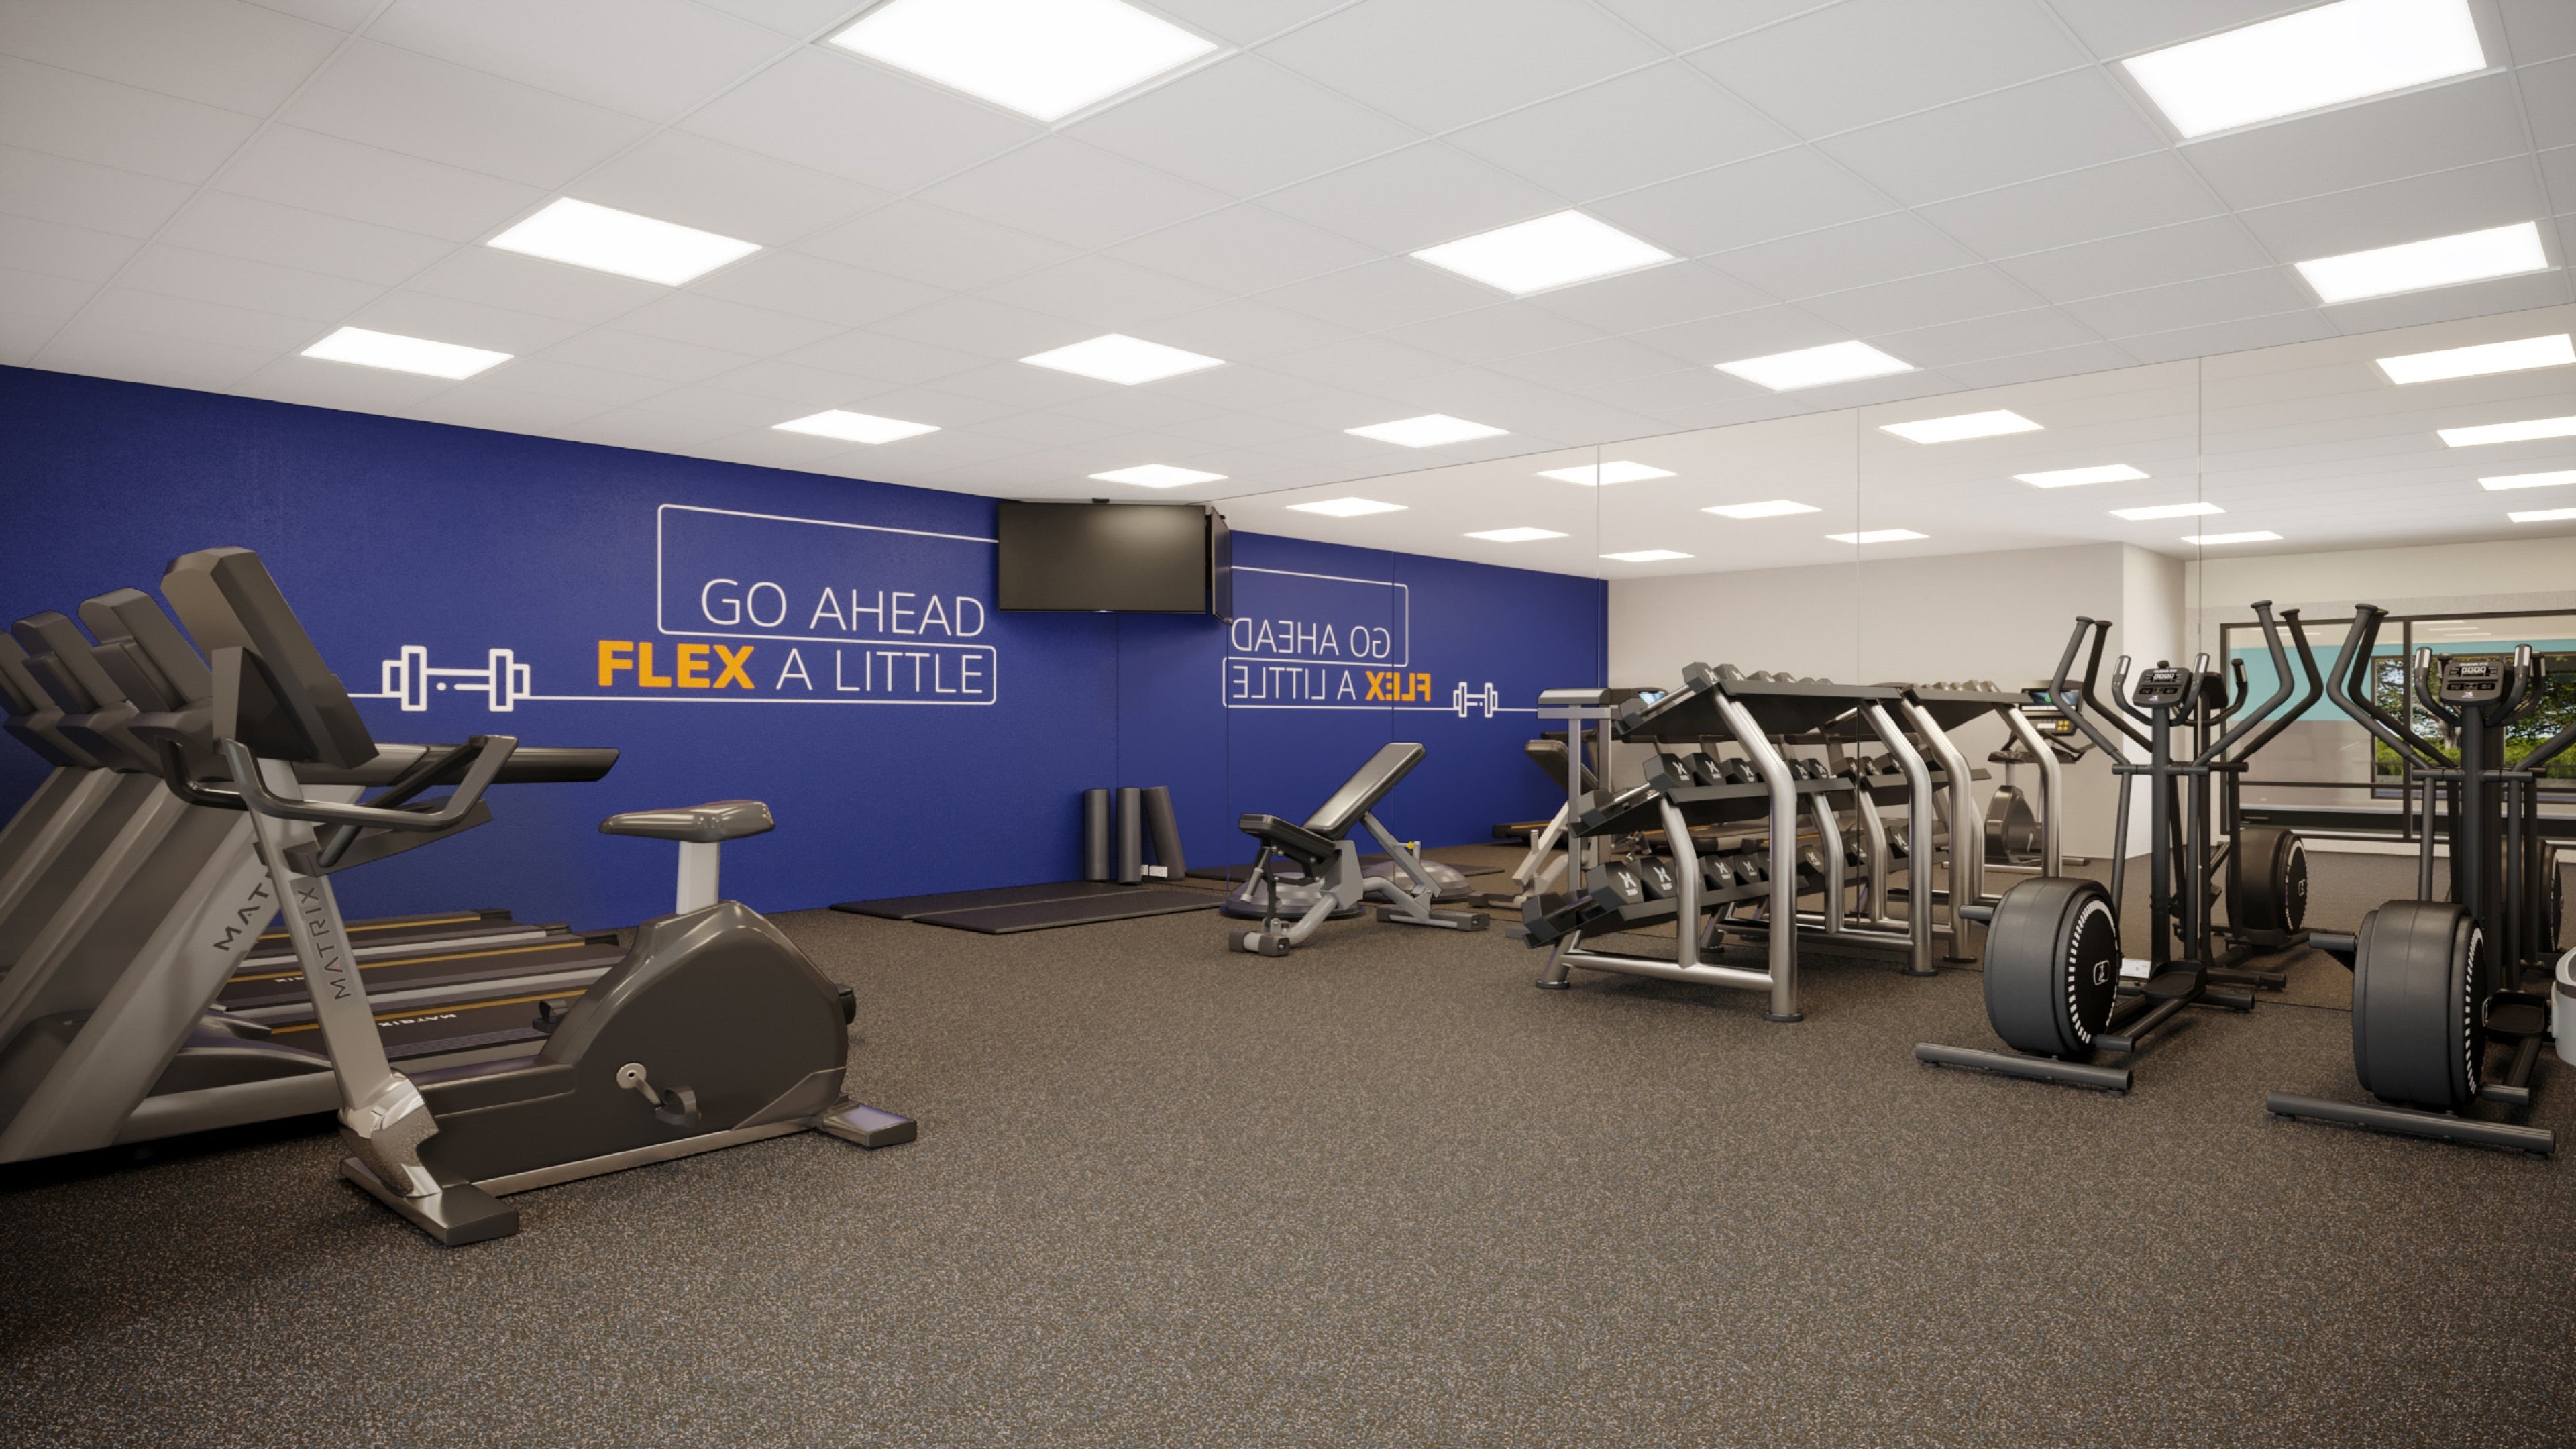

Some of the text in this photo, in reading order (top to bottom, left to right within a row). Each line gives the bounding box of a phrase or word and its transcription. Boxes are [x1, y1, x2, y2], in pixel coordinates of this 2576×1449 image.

[701, 578, 985, 637] GO AHEAD
[598, 640, 983, 694] FLEX A LITTLE
[213, 883, 270, 951] MAT
[297, 886, 352, 1000] MATRIX
[377, 1013, 458, 1027] MATRIX
